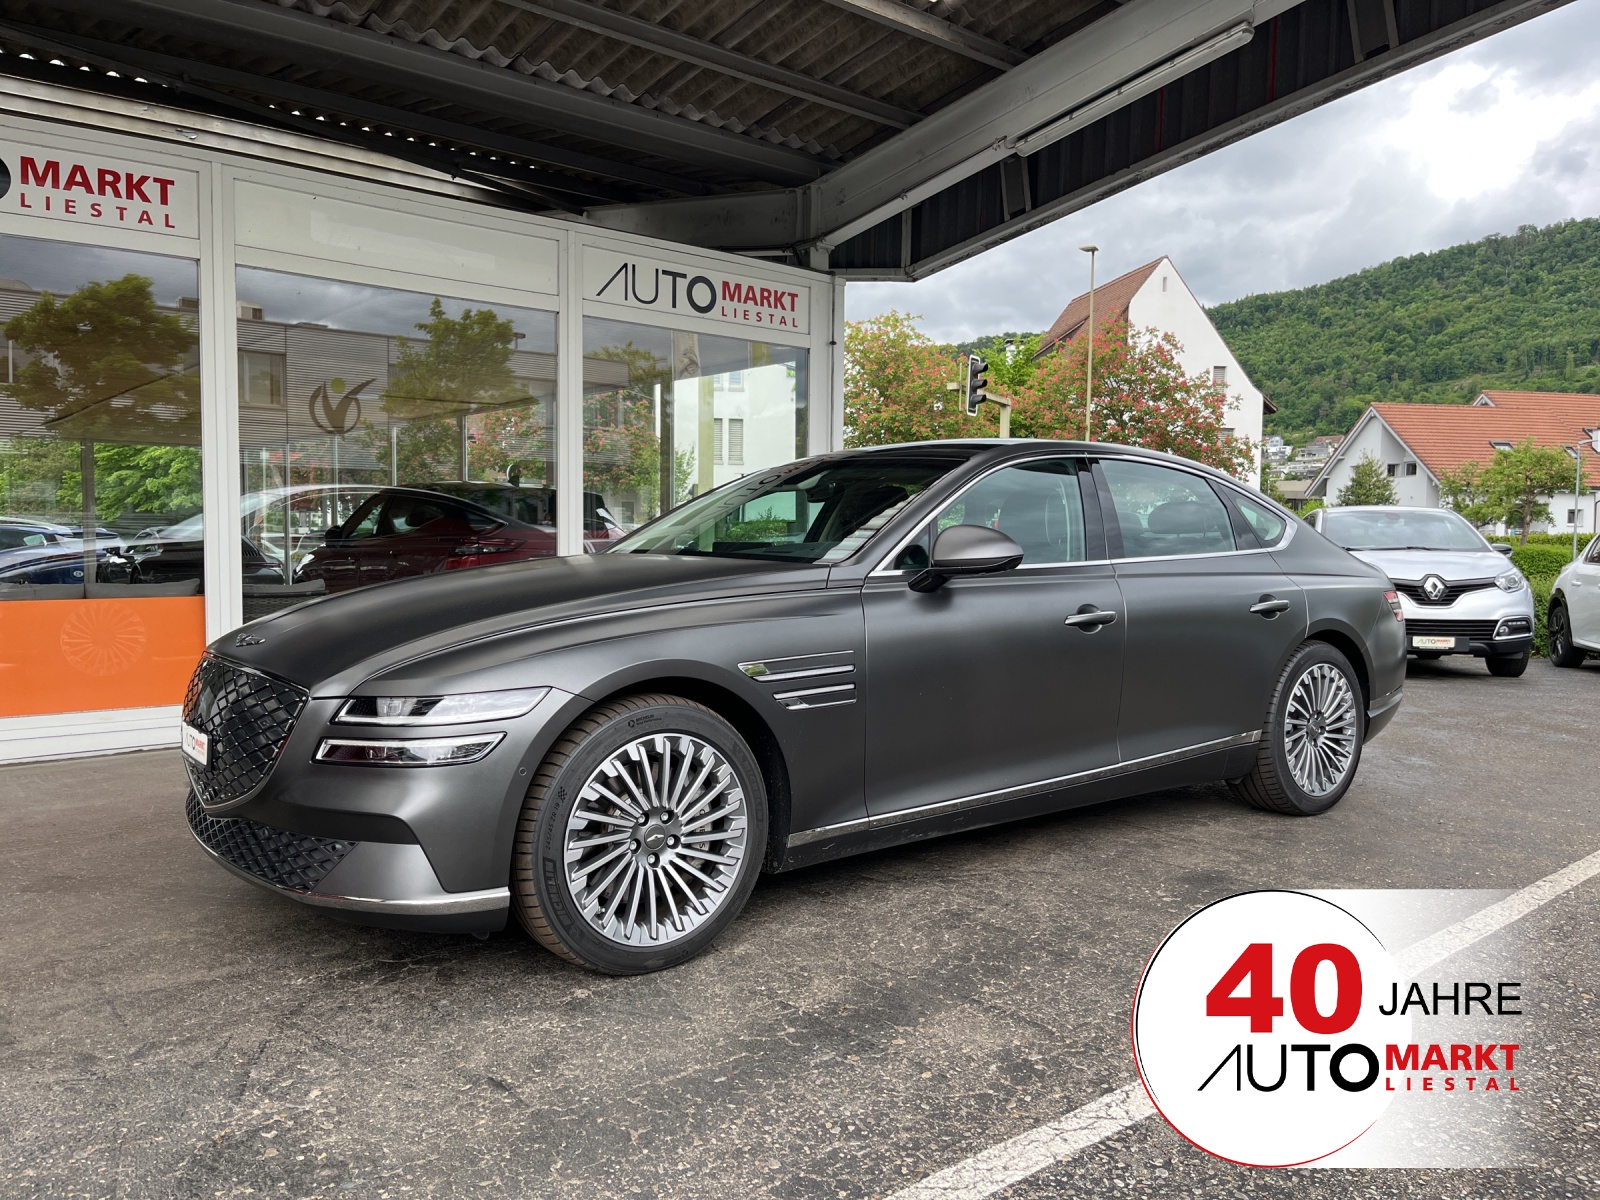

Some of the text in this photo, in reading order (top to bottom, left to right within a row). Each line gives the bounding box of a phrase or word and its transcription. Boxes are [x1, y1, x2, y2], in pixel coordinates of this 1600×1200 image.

[20, 156, 175, 206] MARKT
[20, 192, 175, 229] LIESTAL
[595, 262, 798, 314] AUTO MARKT
[721, 306, 798, 328] LIESTAL
